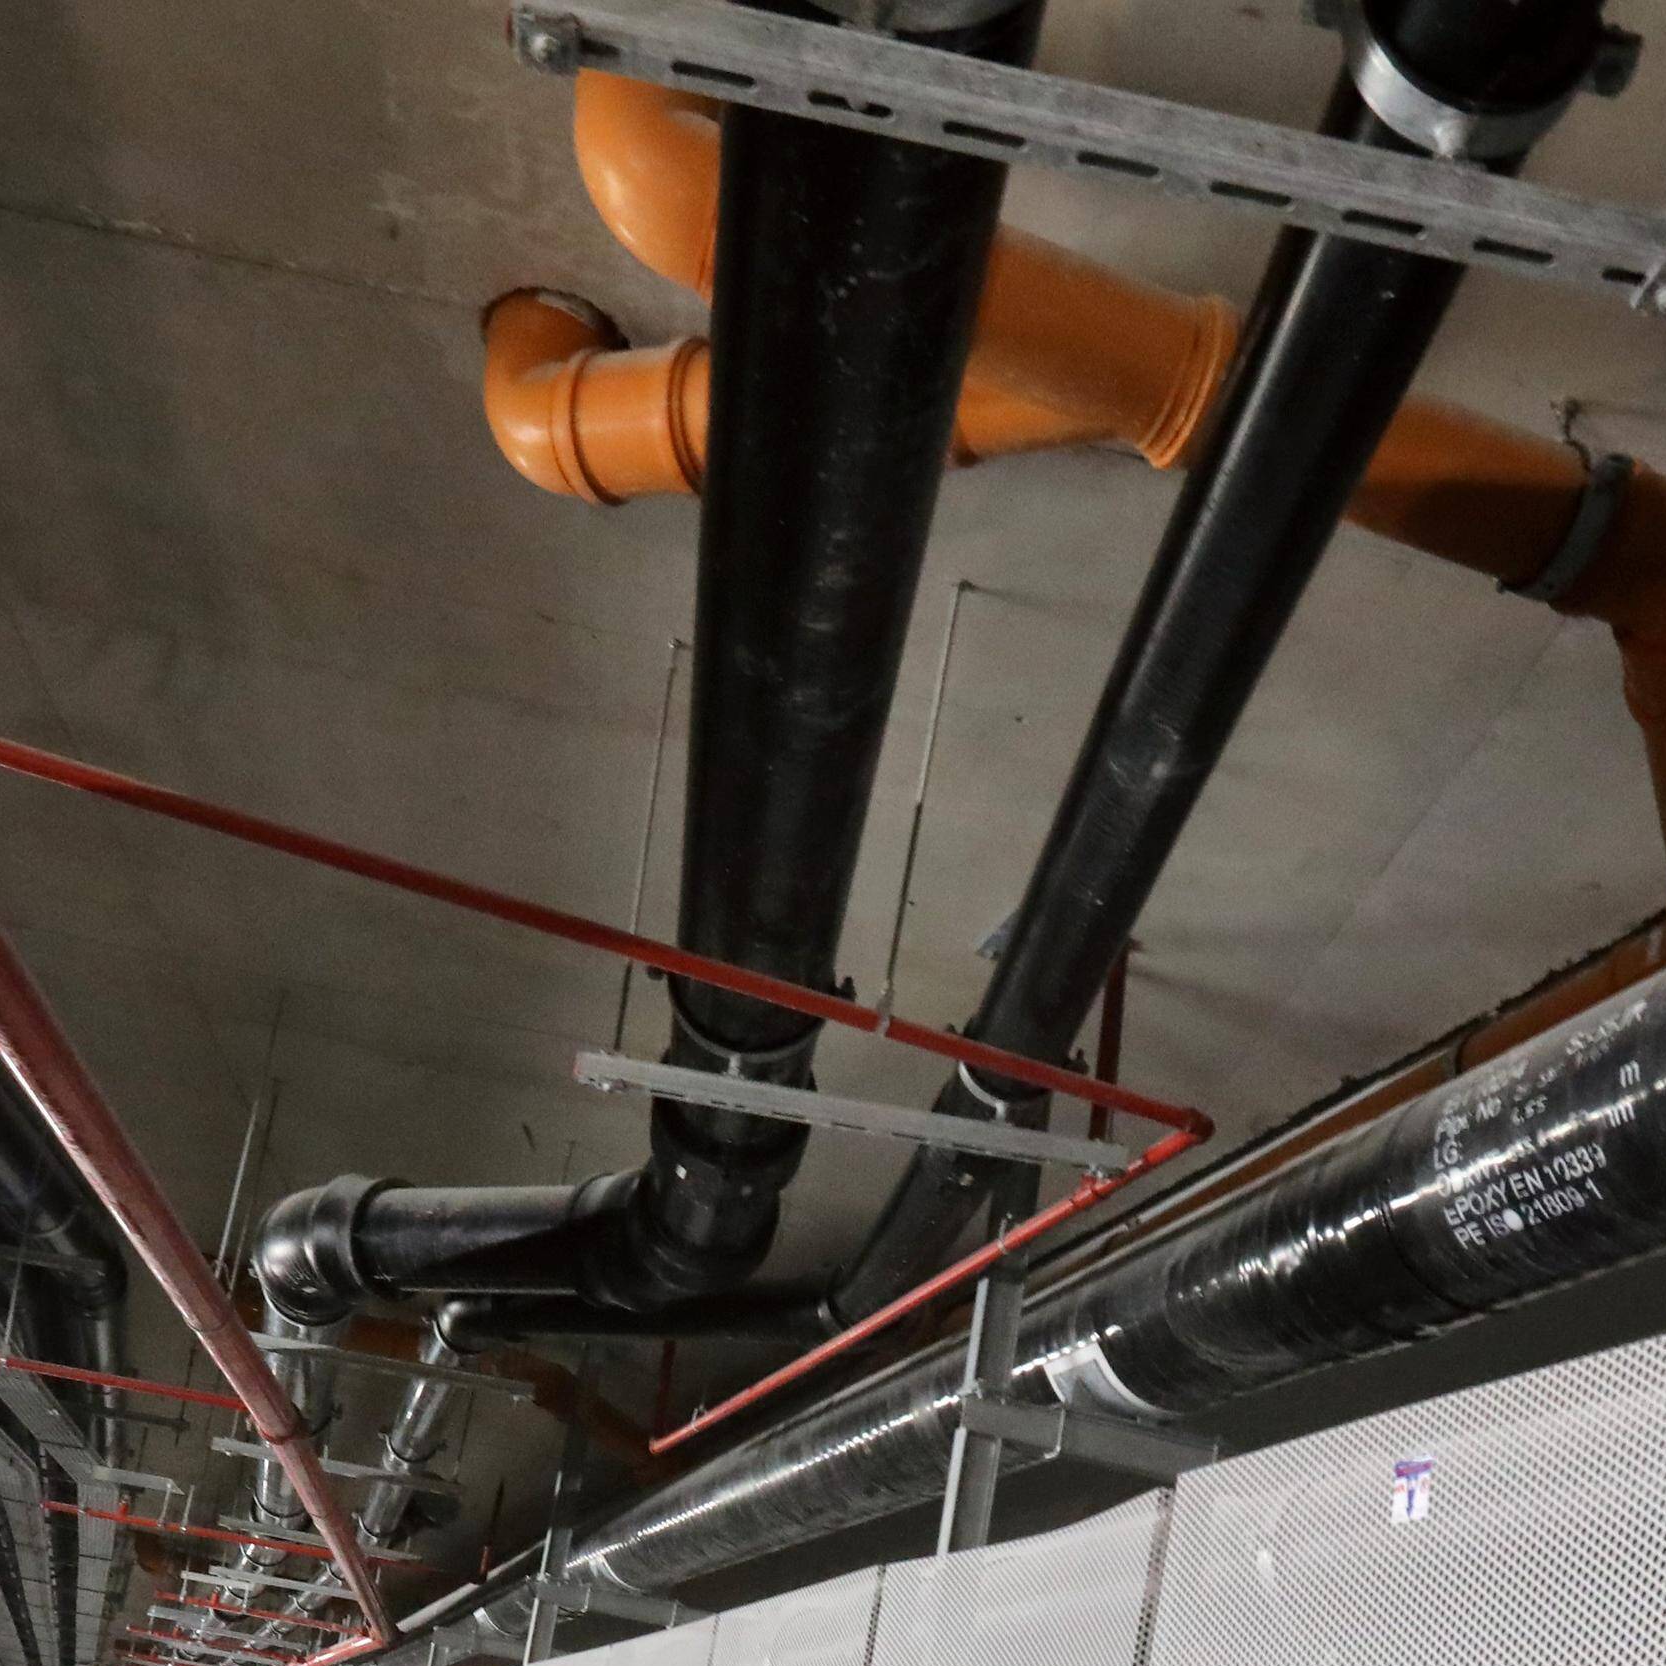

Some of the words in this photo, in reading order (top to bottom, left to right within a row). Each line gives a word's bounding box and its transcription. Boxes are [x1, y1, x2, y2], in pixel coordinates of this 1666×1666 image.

[1443, 1178, 1509, 1226] EPOXY
[1509, 1166, 1546, 1200] EN
[1452, 1221, 1487, 1250] PE
